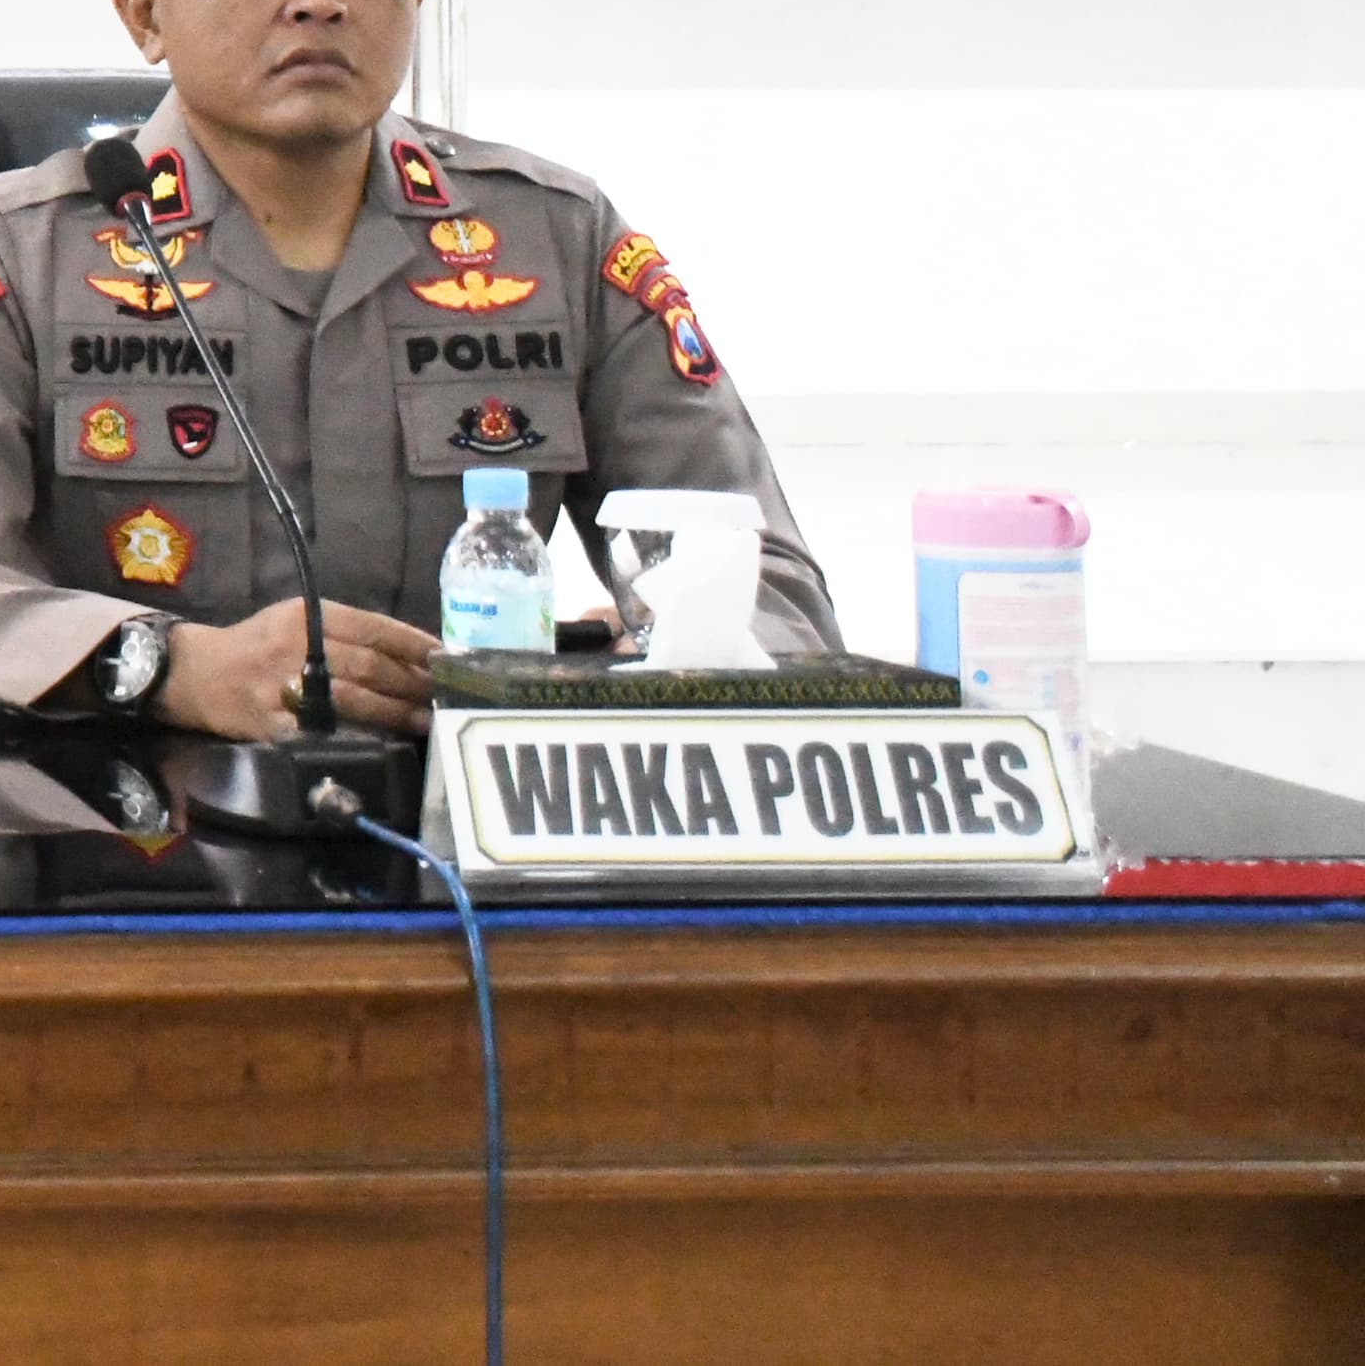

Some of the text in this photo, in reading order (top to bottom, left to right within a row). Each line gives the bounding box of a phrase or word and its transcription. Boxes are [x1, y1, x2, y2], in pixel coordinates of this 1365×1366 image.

[71, 336, 235, 376] SUPIYAN
[406, 331, 563, 374] POLRI
[486, 740, 1044, 838] WAKA POLRES
